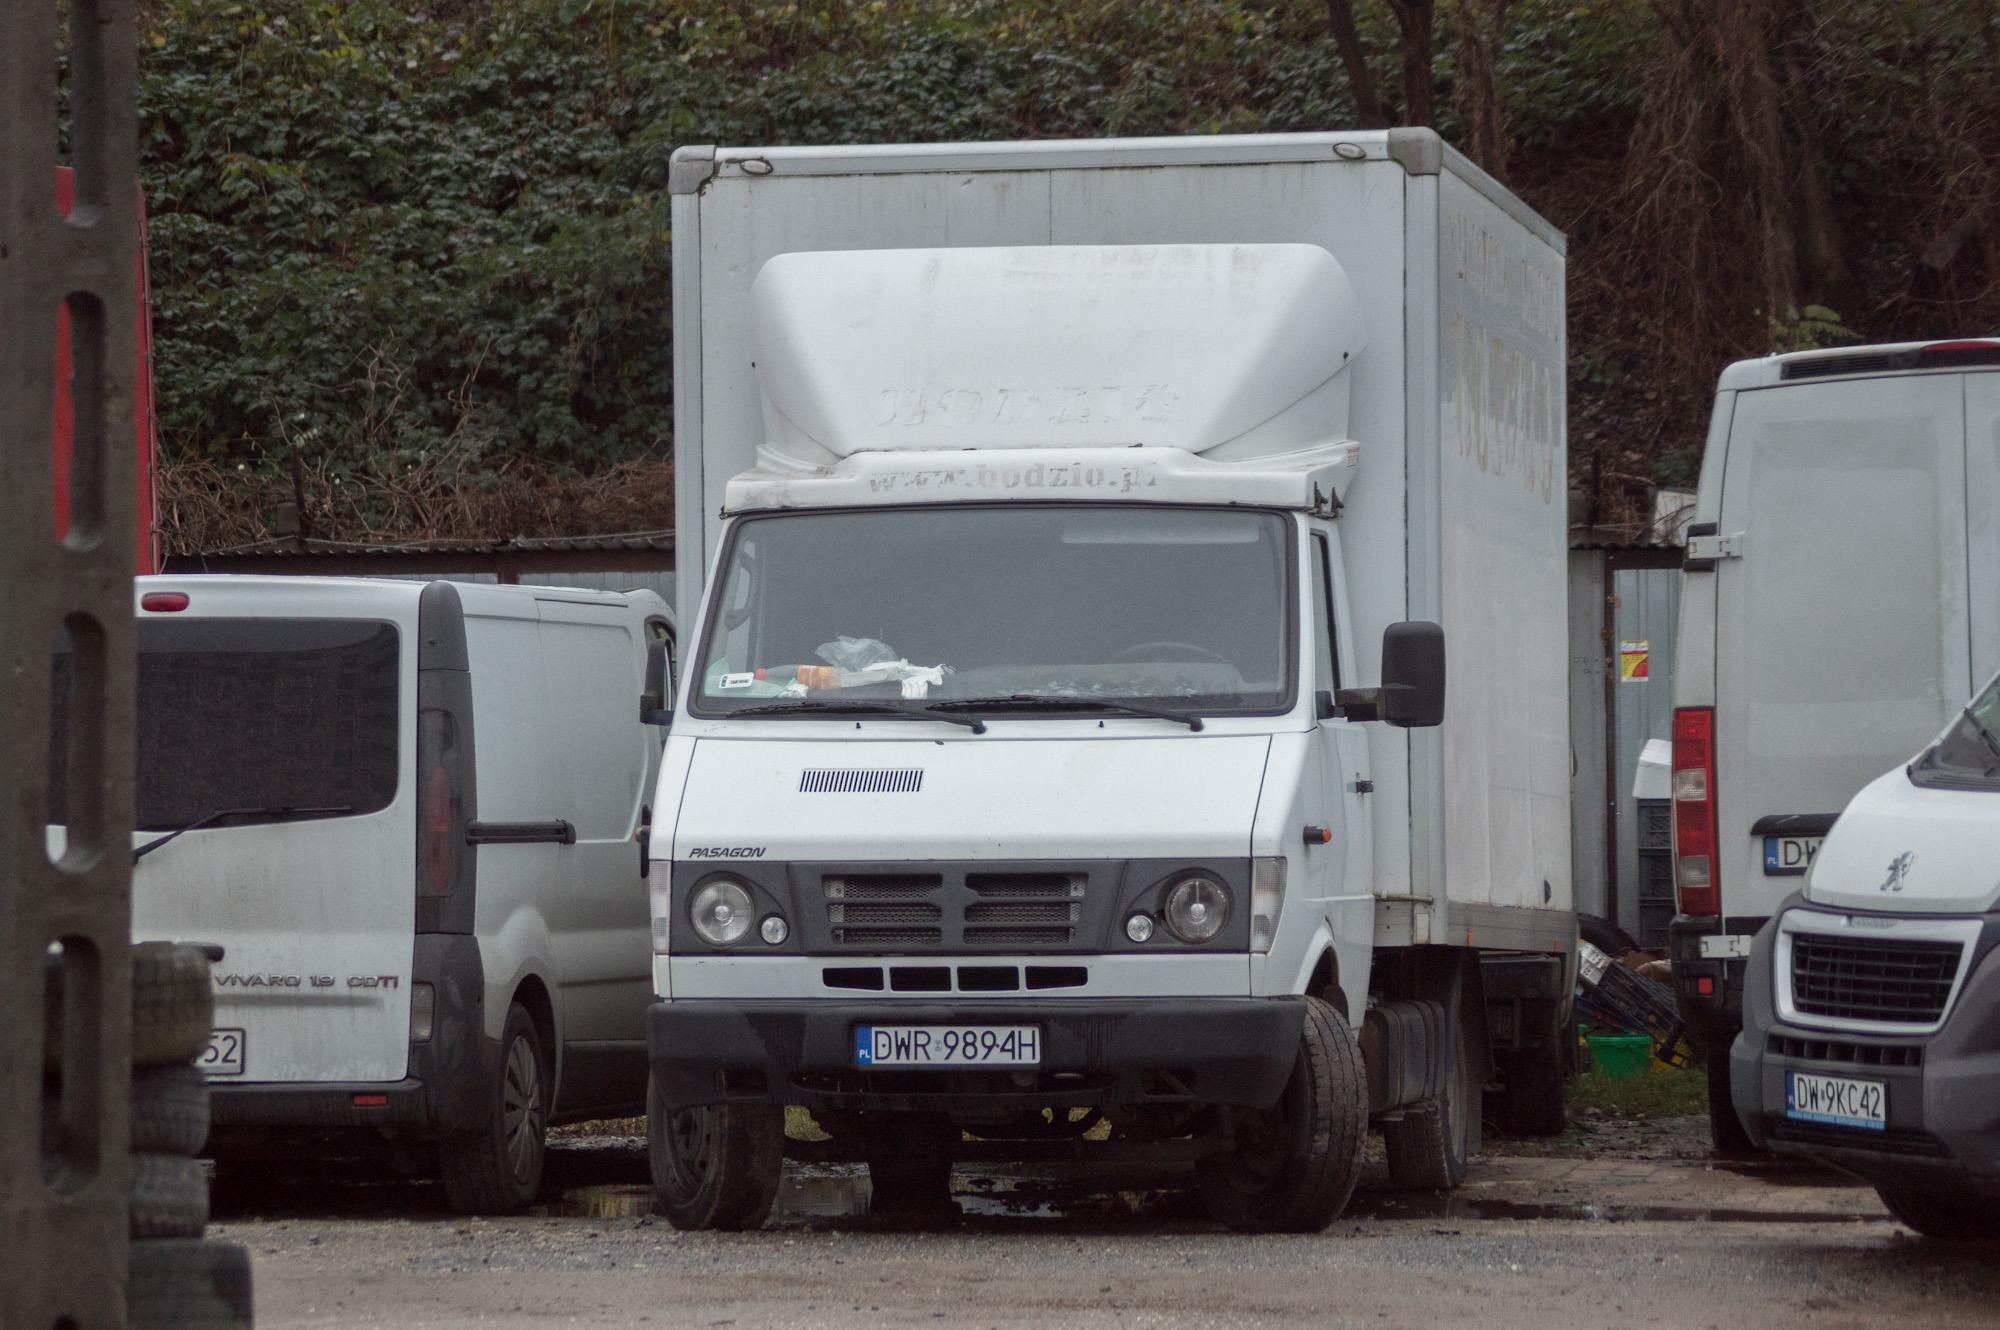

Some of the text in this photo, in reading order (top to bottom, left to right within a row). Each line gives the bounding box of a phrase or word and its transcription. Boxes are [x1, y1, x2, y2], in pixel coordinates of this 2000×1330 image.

[688, 847, 767, 859] PASAGON
[1767, 856, 1778, 864] PL
[214, 973, 301, 987] VIVARO
[347, 974, 398, 989] CDTI
[874, 1030, 1037, 1061] DWR 9894H
[859, 1049, 871, 1059] PL
[1797, 1077, 1881, 1119] DW 9KC42
